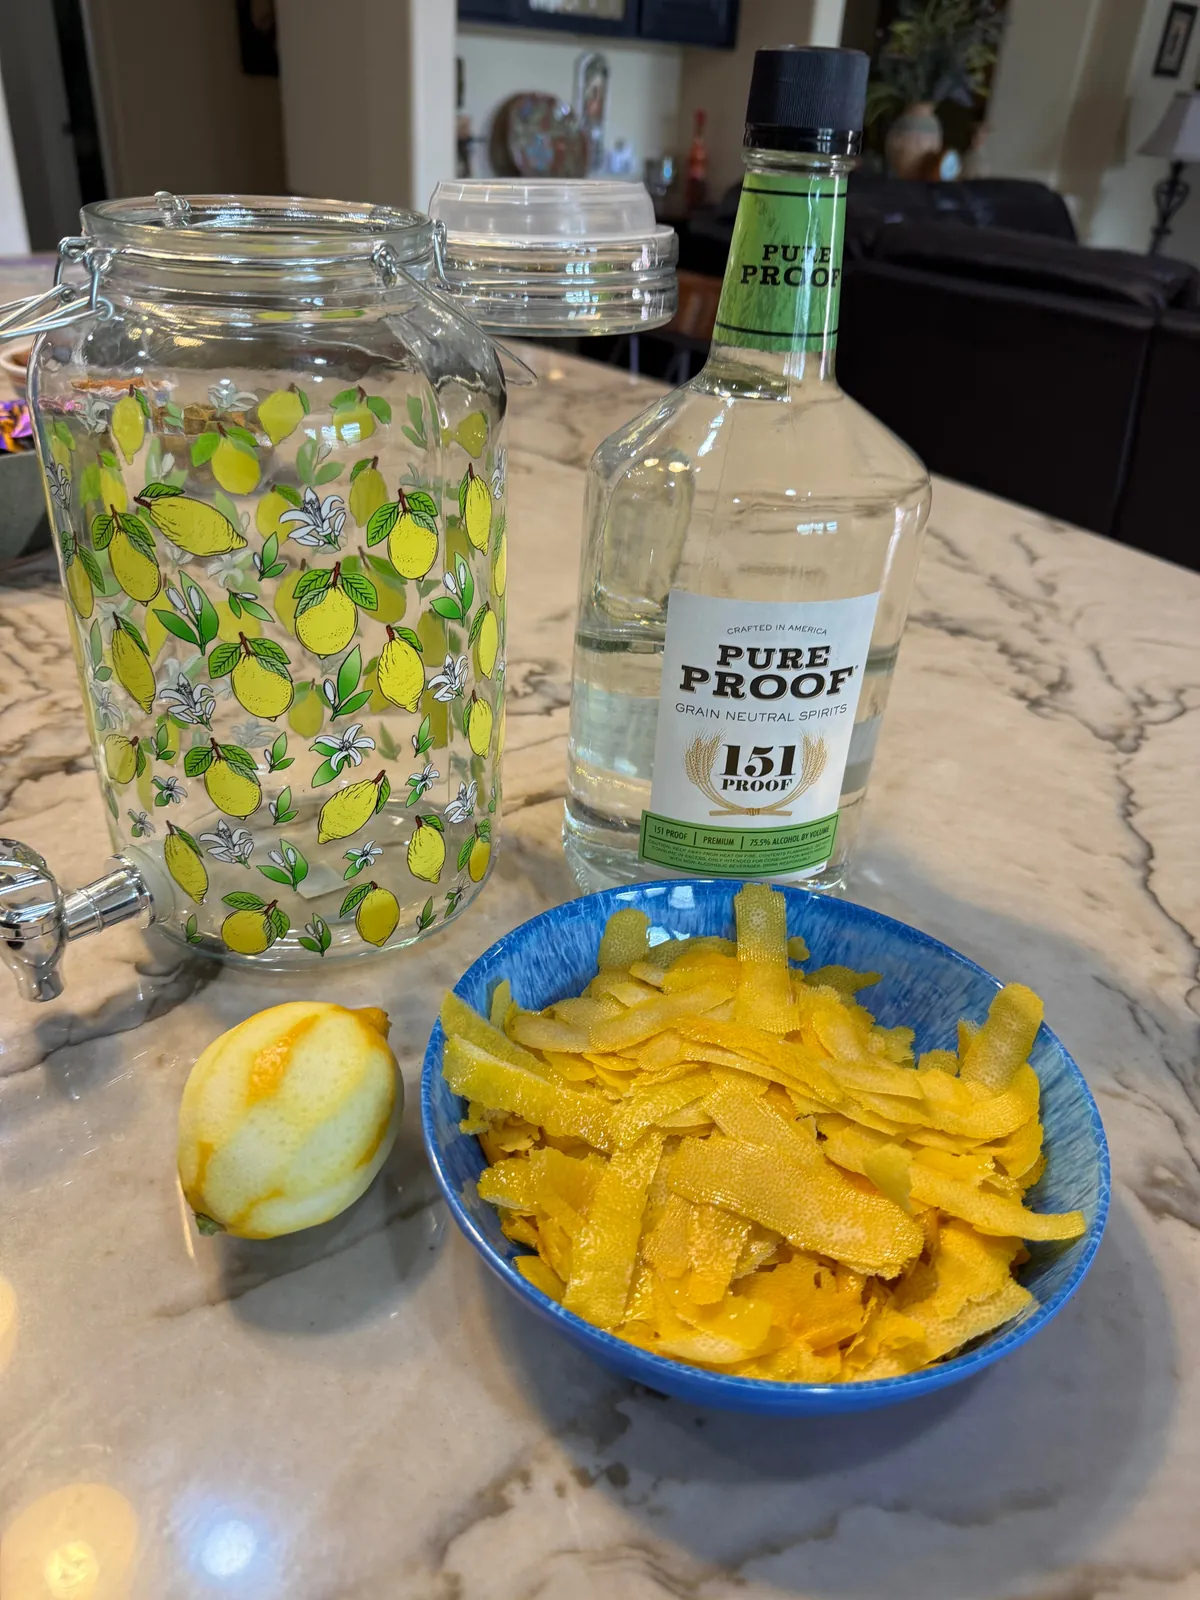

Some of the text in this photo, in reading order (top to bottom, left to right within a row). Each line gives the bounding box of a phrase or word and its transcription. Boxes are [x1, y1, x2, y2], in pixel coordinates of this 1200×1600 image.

[740, 264, 841, 288] PROOF
[726, 624, 773, 635] CRAFTED
[788, 624, 828, 636] AMERICA
[716, 644, 831, 670] PURE
[679, 664, 855, 700] PROOF
[675, 702, 848, 723] GRAIN NEUTRAL SPIRITS
[719, 744, 797, 778] 151
[720, 778, 793, 792] PROOF
[654, 825, 688, 840] 151 PROOF
[703, 836, 735, 846] PREMIUM
[749, 826, 830, 847] 75.5% ALCOHOL BY VOLUME
